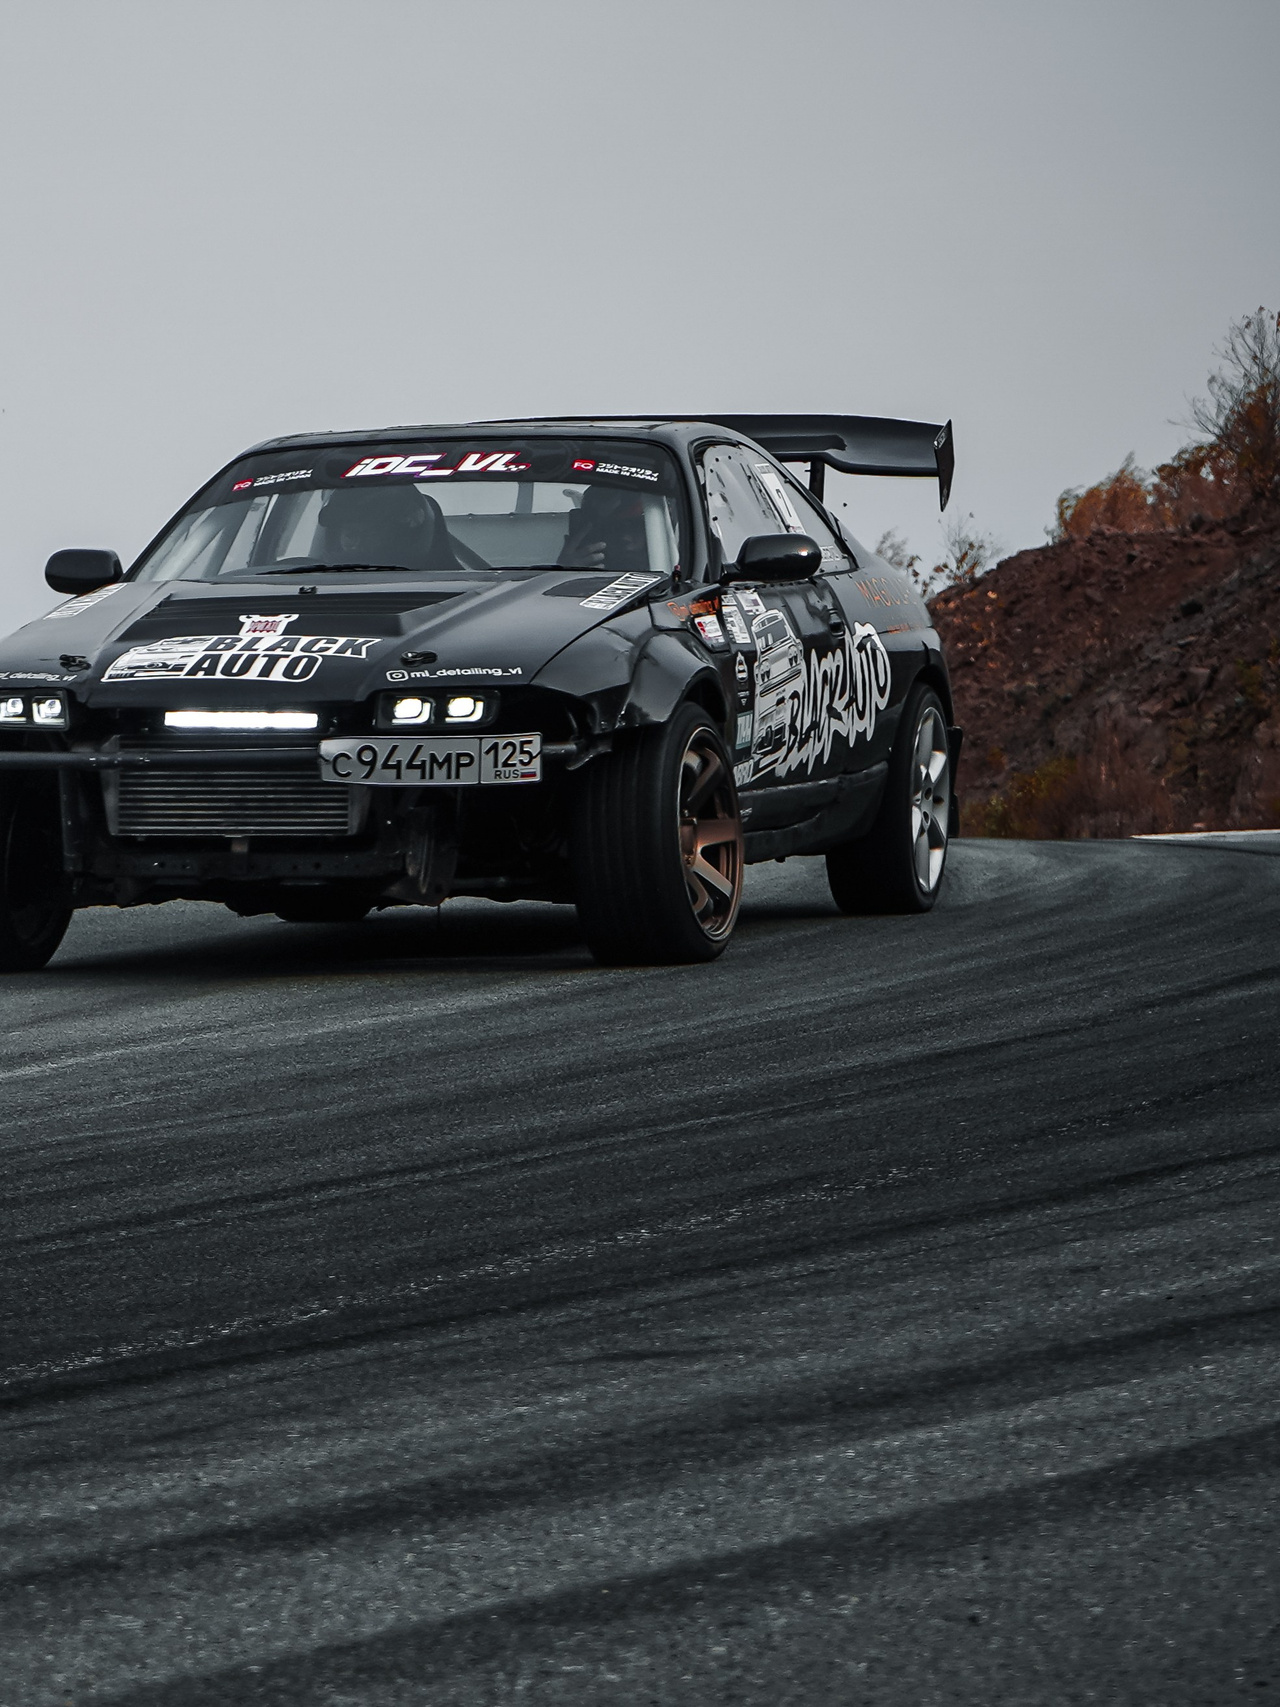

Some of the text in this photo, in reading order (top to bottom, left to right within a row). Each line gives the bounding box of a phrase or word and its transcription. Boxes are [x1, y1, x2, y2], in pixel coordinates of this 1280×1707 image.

[202, 636, 377, 656] BLACK
[183, 653, 319, 679] AUTO
[483, 740, 534, 769] 125
[494, 769, 520, 780] RUS
